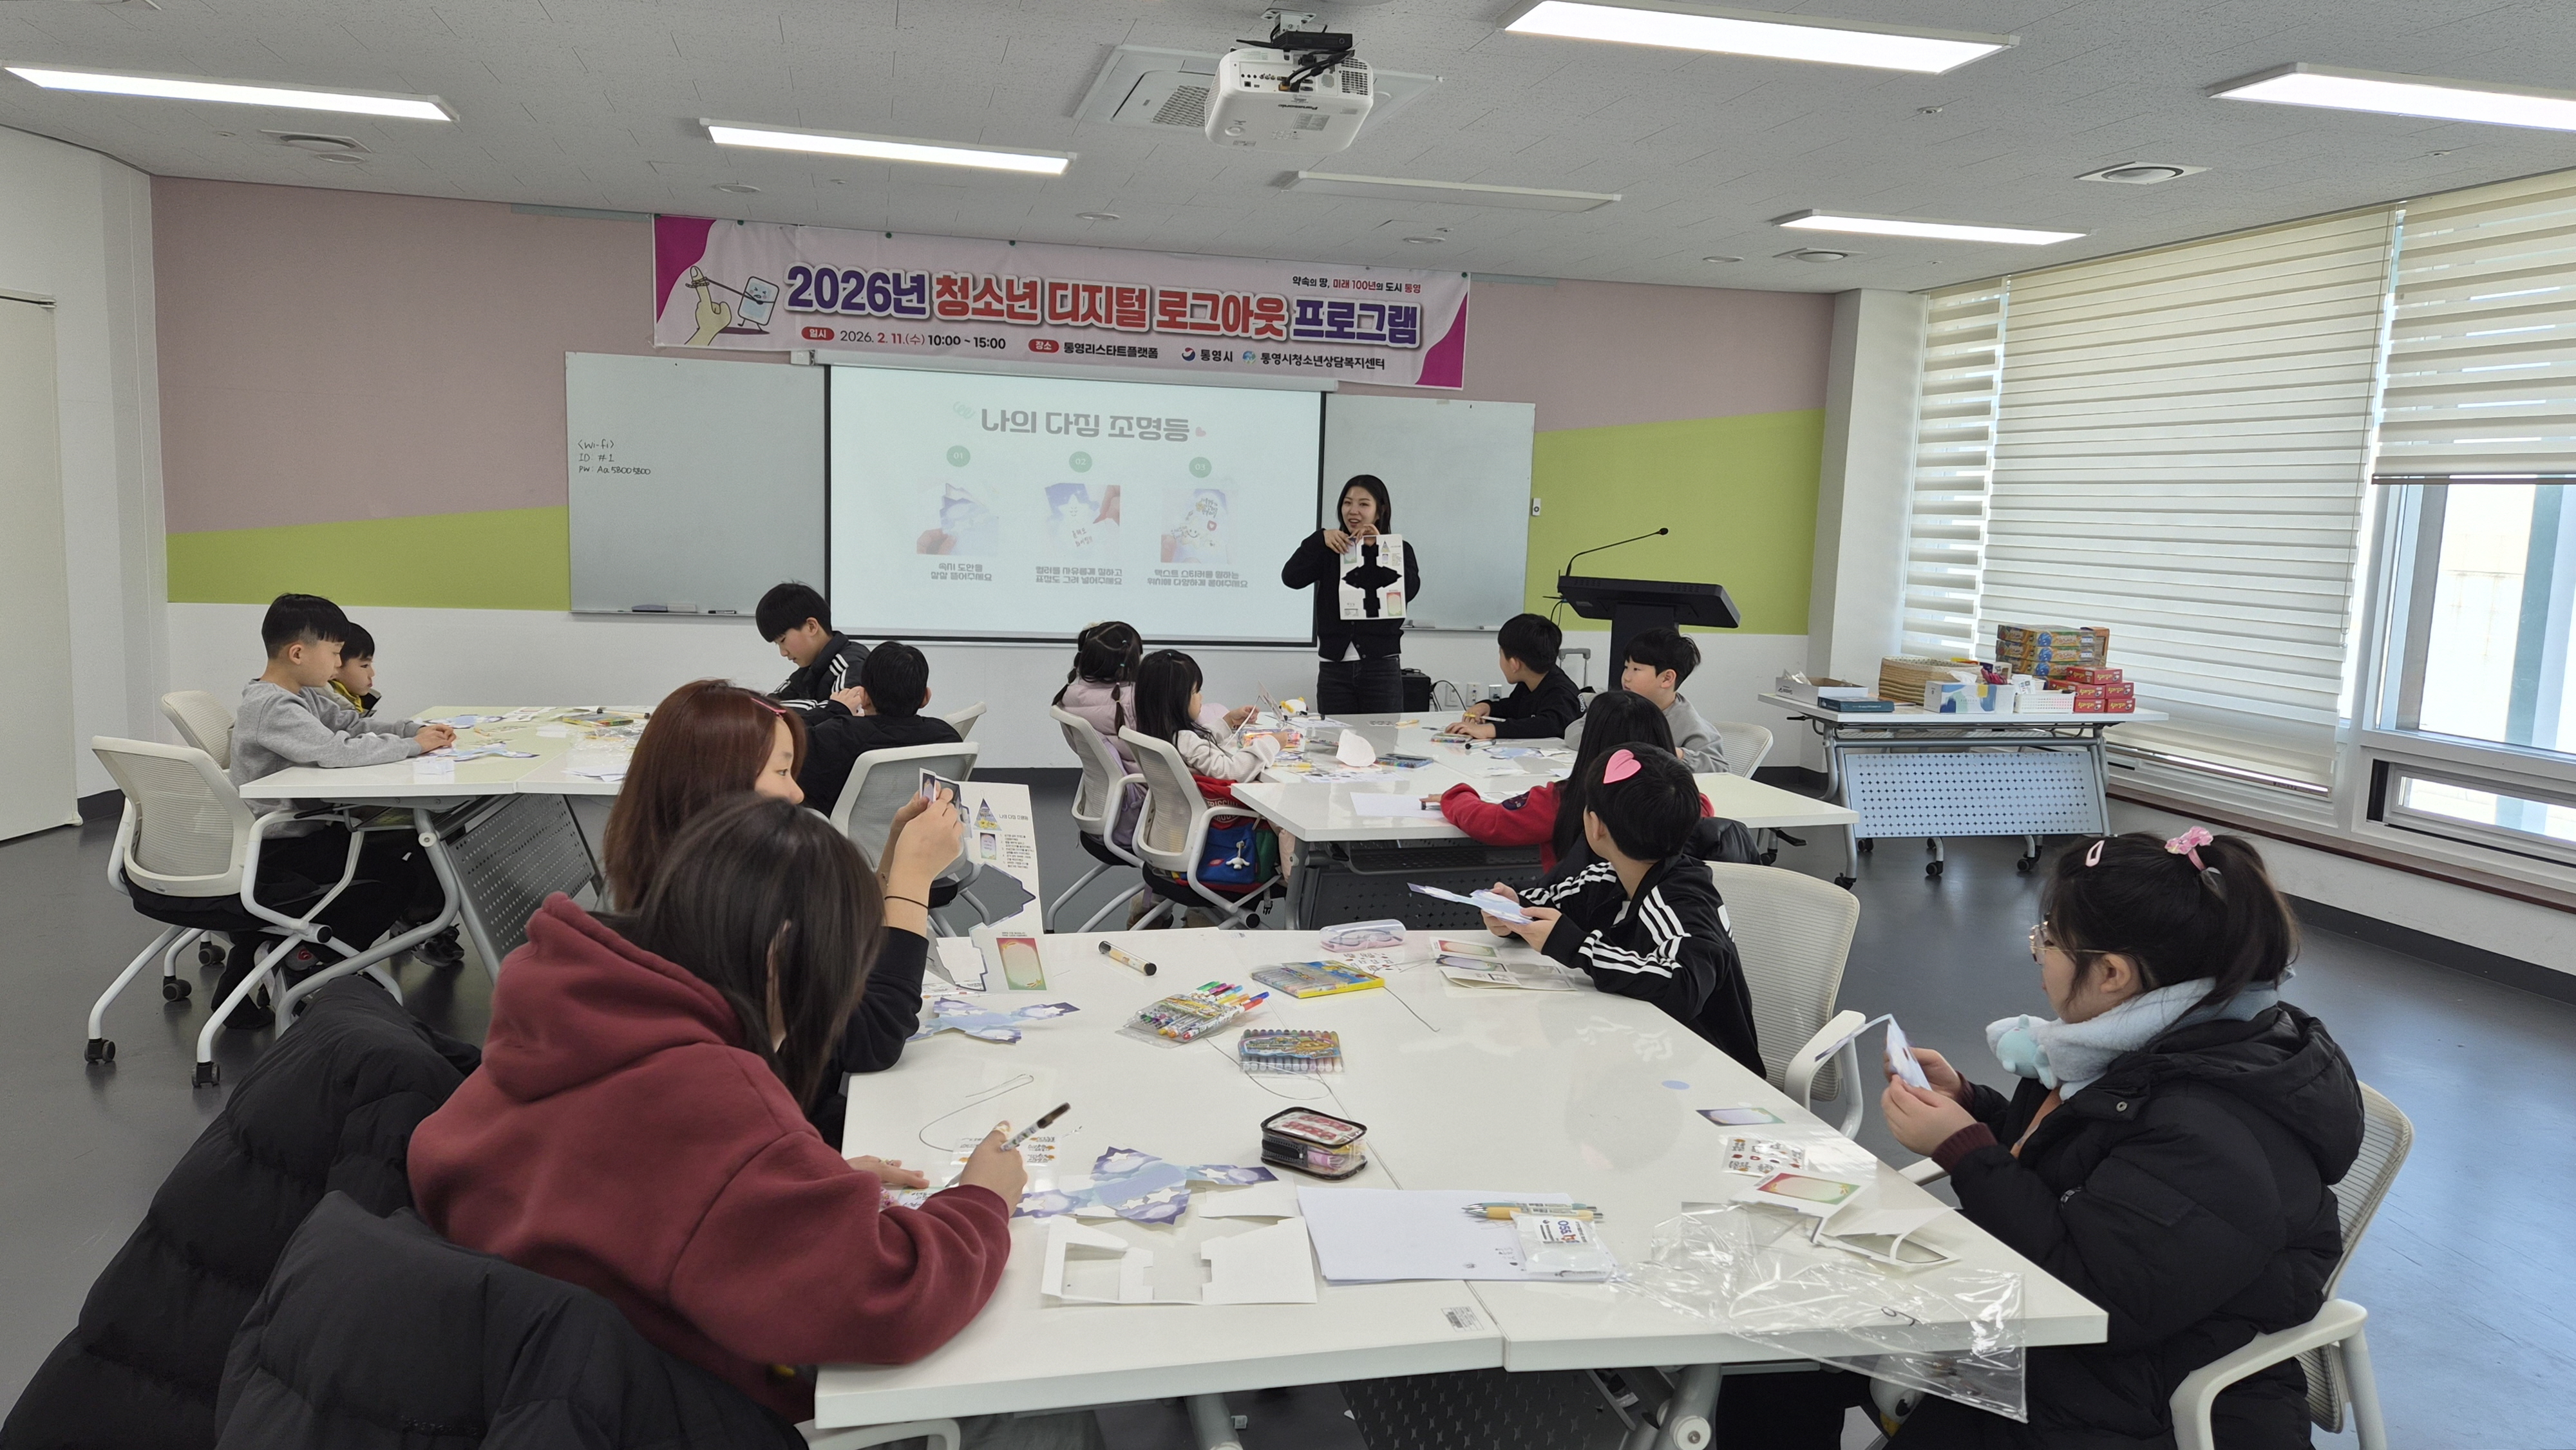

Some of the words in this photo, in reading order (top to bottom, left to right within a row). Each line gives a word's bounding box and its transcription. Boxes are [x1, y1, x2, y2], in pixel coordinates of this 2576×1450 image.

[1293, 276, 1316, 287] 약속의
[1319, 278, 1330, 288] 땅,
[1333, 279, 1349, 288] 미래
[1352, 280, 1383, 290] 100년의
[1385, 283, 1402, 292] 도시
[1405, 284, 1421, 294] 통영
[787, 265, 927, 316] 2026년
[935, 274, 1039, 321] 청소년
[1048, 281, 1148, 328] 디지털
[1158, 292, 1286, 338] 로그아웃
[1294, 299, 1417, 344] 프로그램
[809, 329, 827, 339] 일시
[840, 330, 874, 343] 2026.
[877, 332, 888, 343] 2.
[928, 335, 961, 346] 10:00
[974, 337, 1006, 349] 15:00
[1035, 341, 1052, 350] 장소
[1063, 342, 1159, 359] 통영리스타트플랫폼
[1200, 350, 1233, 362] 통영시
[1260, 352, 1385, 370] 통영시청소년상담복지센터
[981, 408, 1037, 433] 나의
[1045, 411, 1100, 438] 다짐
[1108, 415, 1190, 442] 조명등
